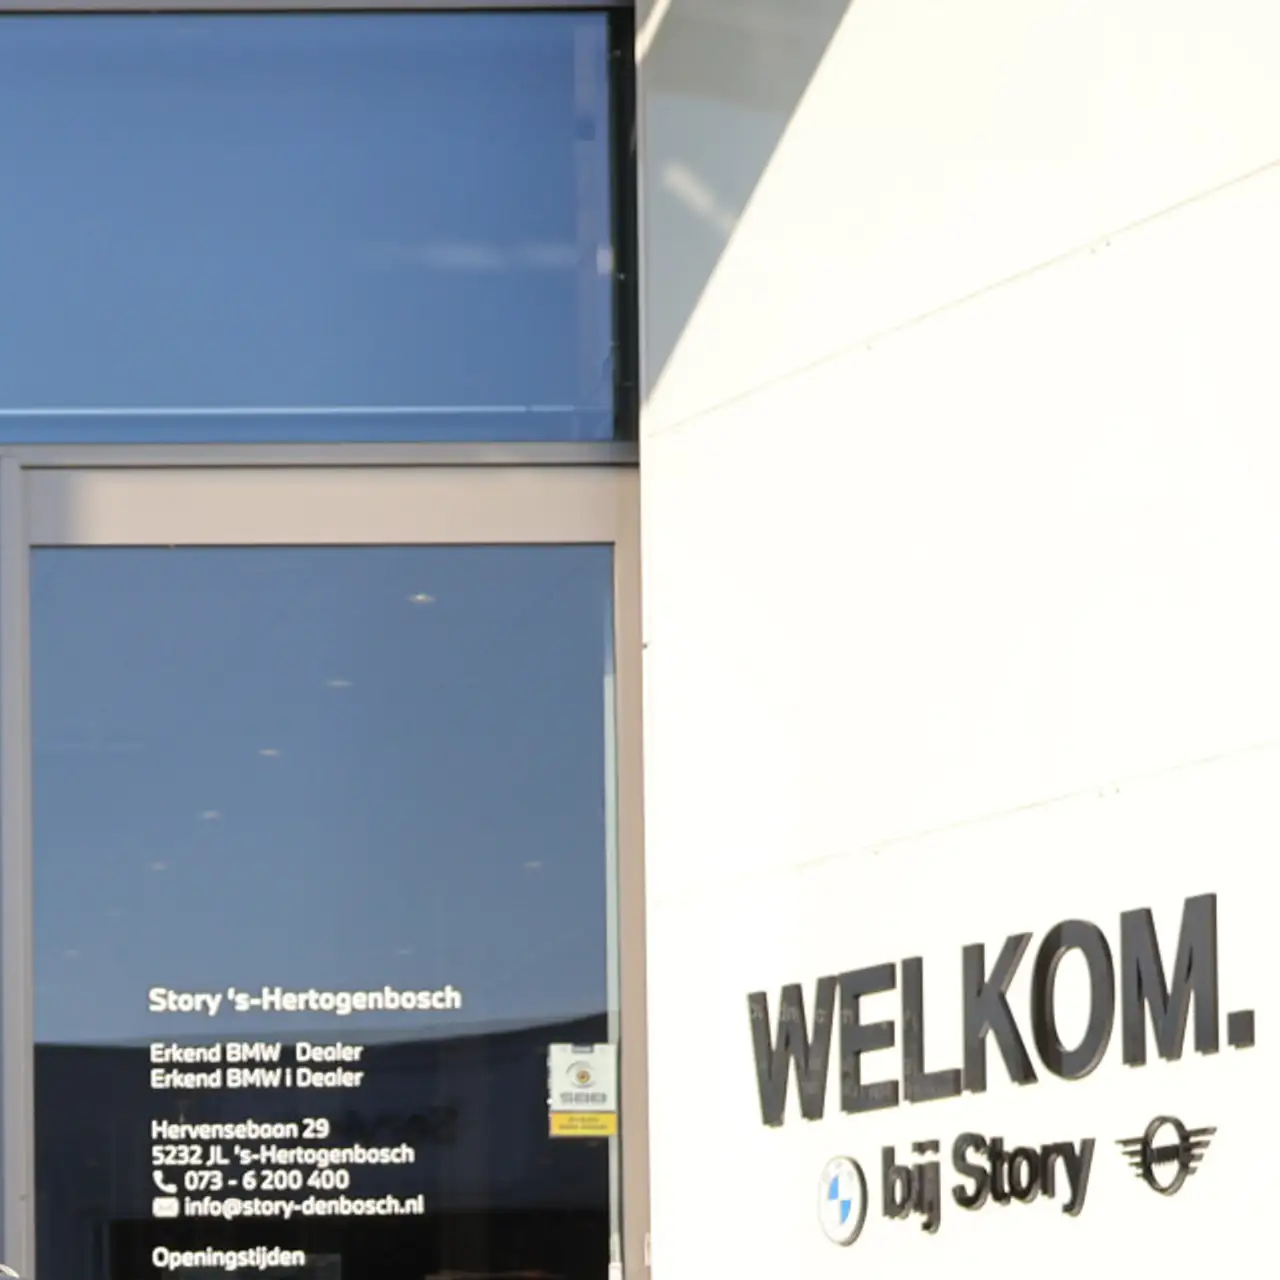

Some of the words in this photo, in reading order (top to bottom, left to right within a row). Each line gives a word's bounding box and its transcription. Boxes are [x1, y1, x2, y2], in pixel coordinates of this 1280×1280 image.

[148, 987, 222, 1016] Story
[227, 984, 462, 1016] 's-Hertogenbosch
[747, 892, 1255, 1127] WELKOM.
[150, 1042, 222, 1063] Erkend
[226, 1042, 281, 1062] BMW
[295, 1042, 364, 1062] Dealer
[150, 1068, 222, 1089] Erkend
[226, 1068, 281, 1088] BMW
[285, 1068, 292, 1088] i
[295, 1067, 365, 1088] Dealer
[151, 1118, 299, 1139] Hervensebaan
[302, 1117, 330, 1139] 29
[151, 1144, 203, 1165] 5232
[206, 1144, 230, 1167] JL
[234, 1142, 415, 1168] 's-Hertogenbosch
[184, 1169, 223, 1191] 073
[242, 1169, 257, 1190] 6
[260, 1169, 303, 1190] 200
[306, 1168, 350, 1190] 400
[882, 1139, 941, 1234] bij
[952, 1132, 1096, 1217] Story
[184, 1194, 425, 1220] info@story-denbosch.nl
[152, 1246, 306, 1271] Openingstijden
